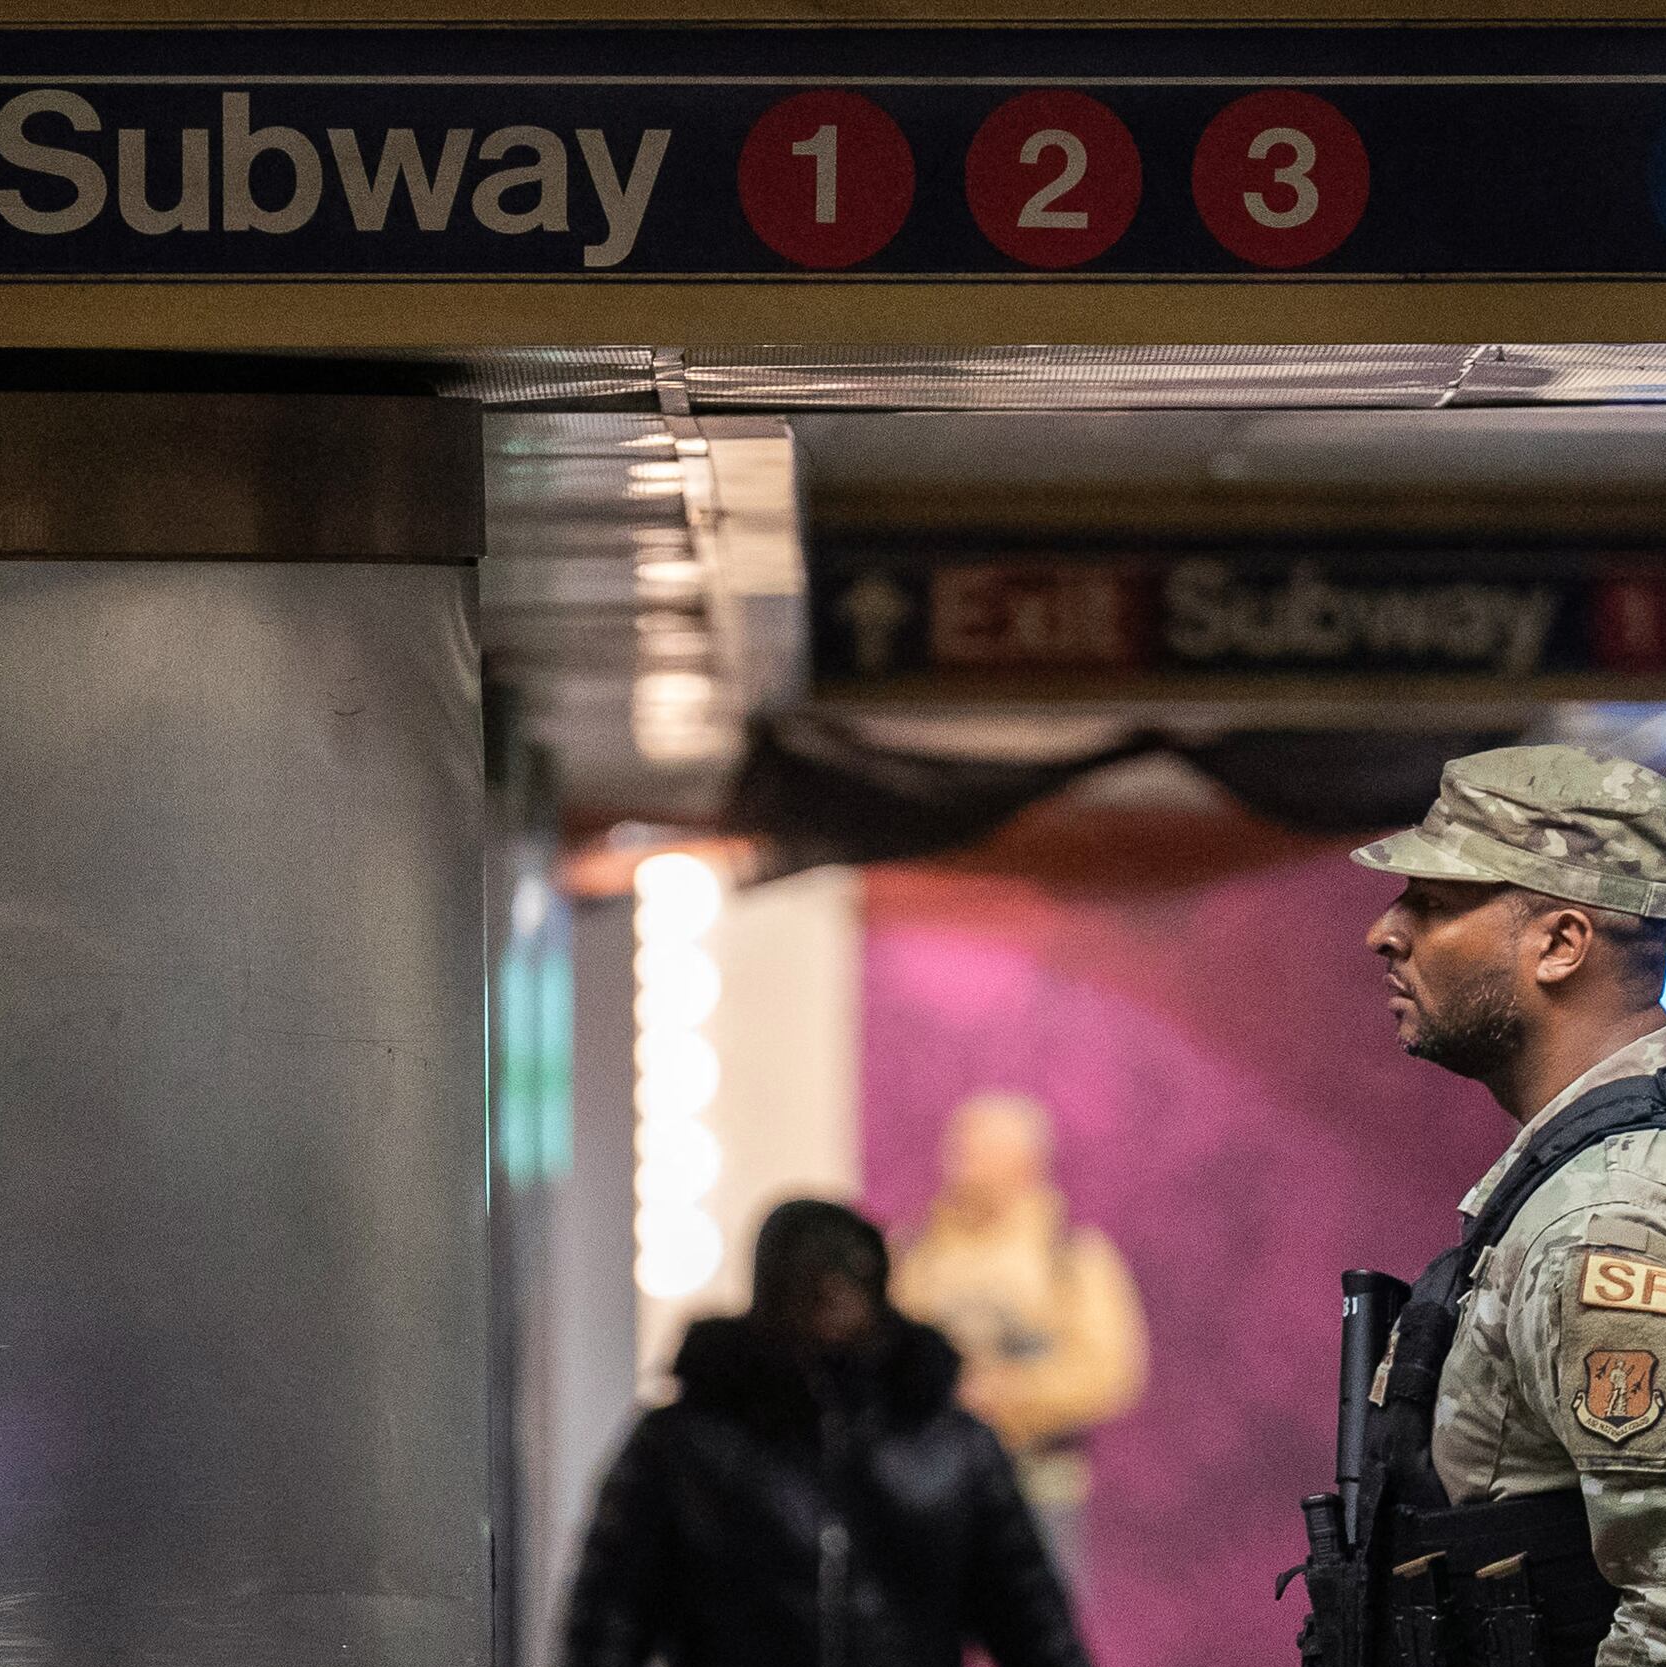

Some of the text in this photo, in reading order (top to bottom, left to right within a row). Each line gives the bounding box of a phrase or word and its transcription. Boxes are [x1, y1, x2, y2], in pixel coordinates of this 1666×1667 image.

[792, 126, 837, 223] 1
[1018, 129, 1088, 229] 2
[1244, 127, 1319, 228] 3
[1166, 558, 1555, 679] Subway
